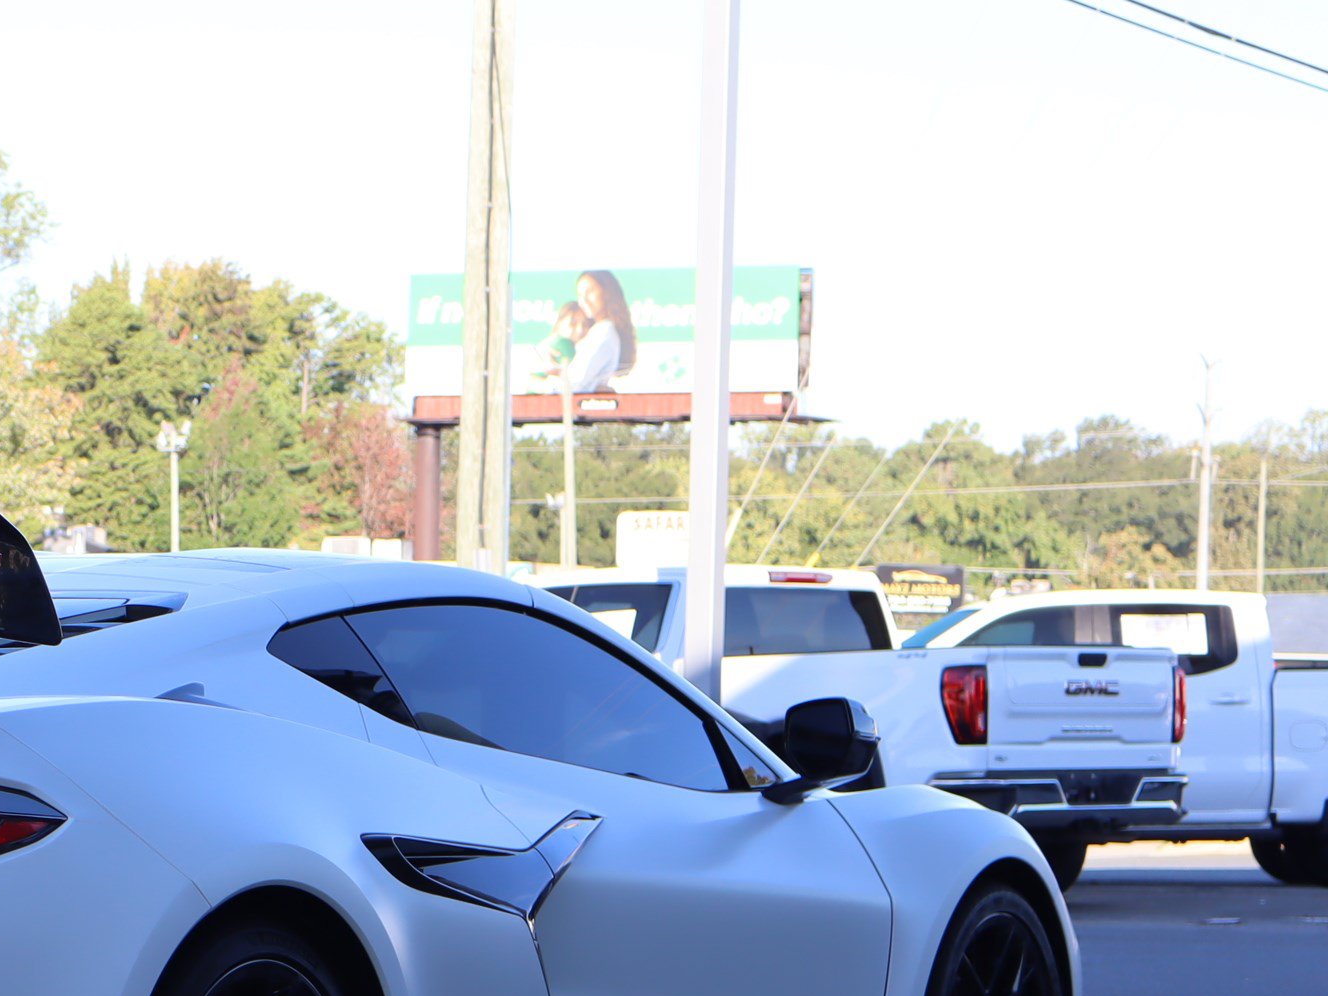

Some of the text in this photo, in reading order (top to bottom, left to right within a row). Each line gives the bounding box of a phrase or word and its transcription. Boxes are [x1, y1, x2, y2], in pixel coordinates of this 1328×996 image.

[512, 299, 555, 325] ou,
[730, 296, 790, 326] ho?
[634, 515, 686, 531] SAFAR
[1064, 679, 1119, 696] GMC
